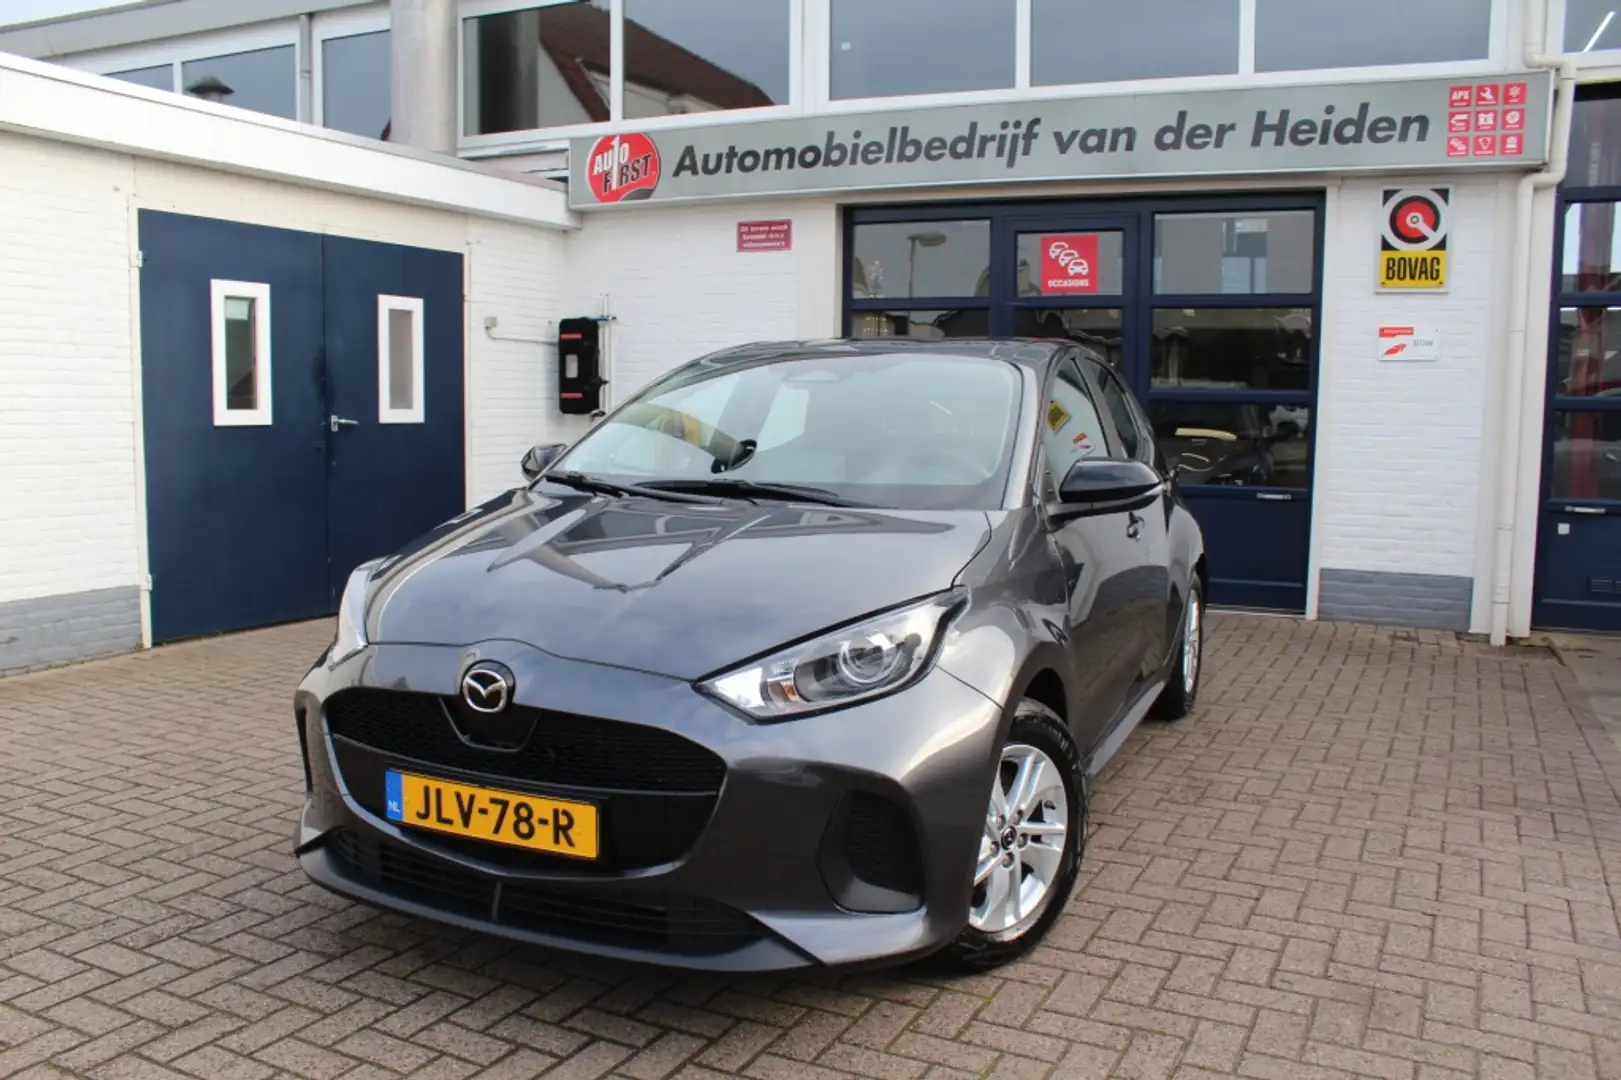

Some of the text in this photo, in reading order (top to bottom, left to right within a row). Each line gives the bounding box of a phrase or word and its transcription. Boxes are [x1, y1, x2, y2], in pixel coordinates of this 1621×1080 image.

[672, 102, 1430, 178] Automobielbedrijf van der Heiden
[1385, 256, 1441, 281] BOVAG
[388, 799, 402, 813] NL
[415, 785, 576, 848] JLV-78-R
